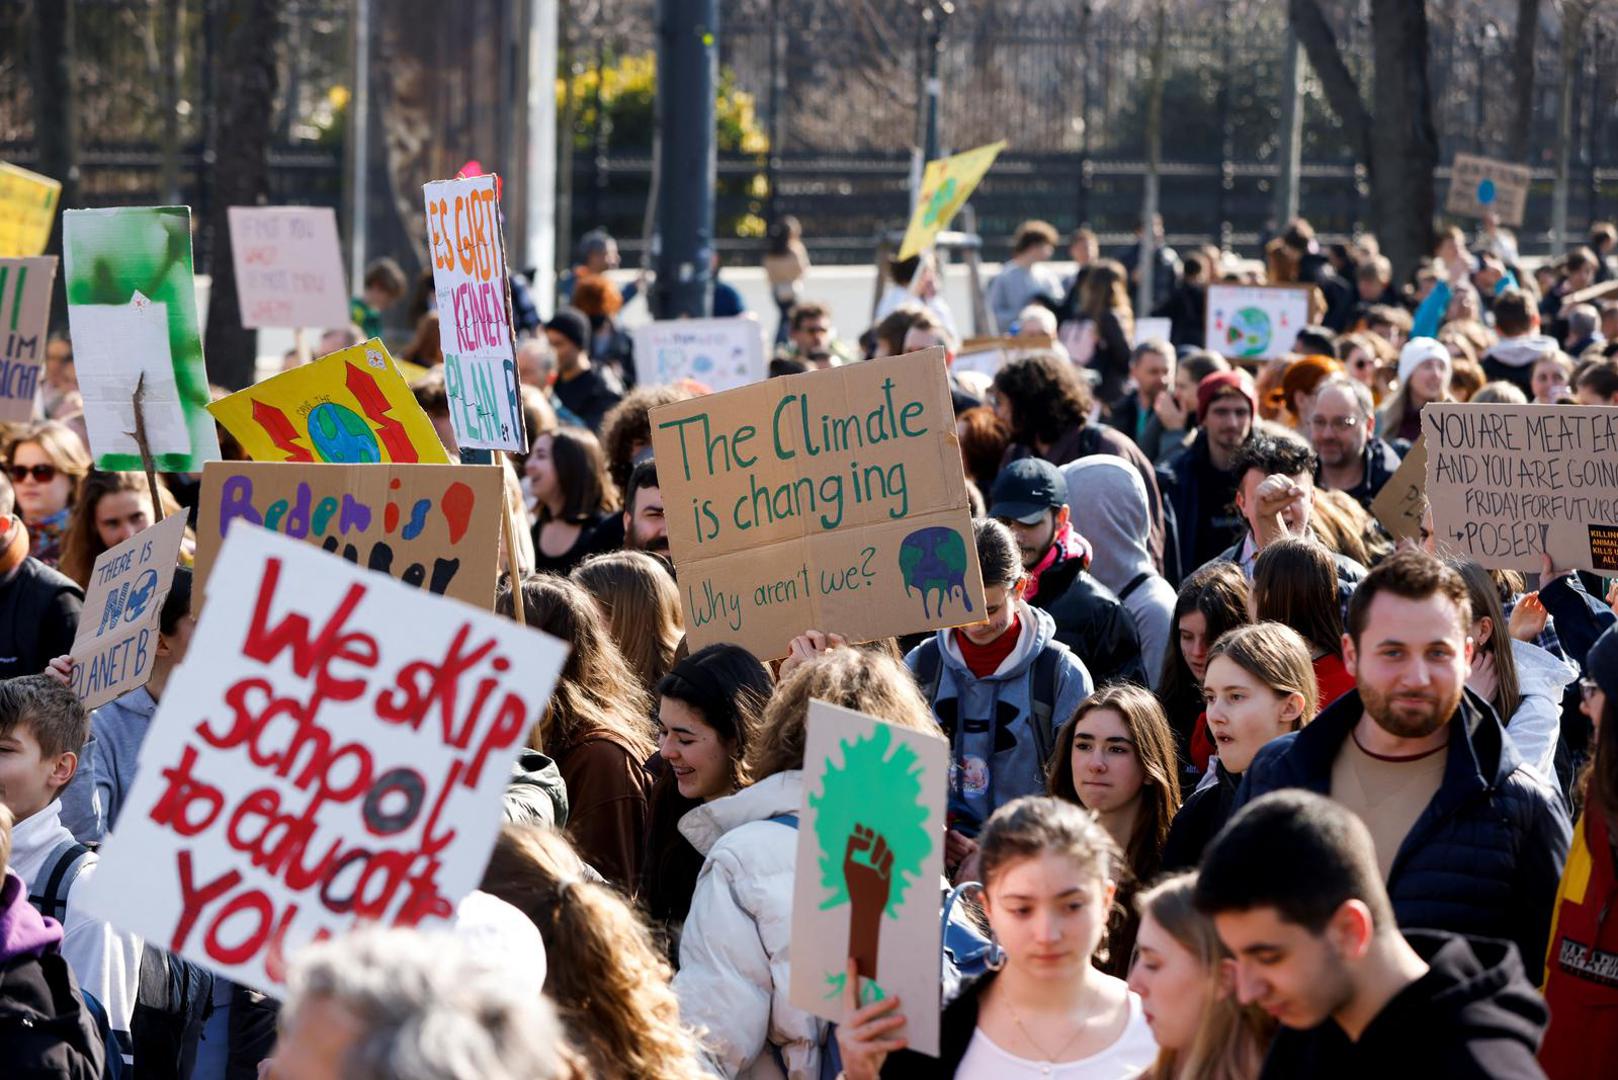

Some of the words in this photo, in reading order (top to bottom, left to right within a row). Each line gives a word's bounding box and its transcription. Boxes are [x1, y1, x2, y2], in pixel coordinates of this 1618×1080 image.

[430, 198, 455, 273] ES
[658, 412, 758, 482] The
[772, 377, 929, 460] Climate
[1526, 415, 1587, 453] MEAT
[1591, 414, 1618, 453] EA
[692, 497, 720, 543] is
[733, 461, 908, 530] changing
[1436, 452, 1478, 484] AND
[1481, 453, 1513, 488] YOU
[1517, 457, 1564, 490] ARE
[97, 549, 136, 587] THERE
[139, 540, 153, 564] IS
[688, 579, 742, 632] Why
[753, 563, 810, 608] aren't
[820, 547, 877, 595] we?
[69, 635, 136, 701] PLANET
[134, 628, 150, 678] B
[242, 556, 380, 701] We
[149, 744, 225, 837] to
[194, 677, 456, 853] school
